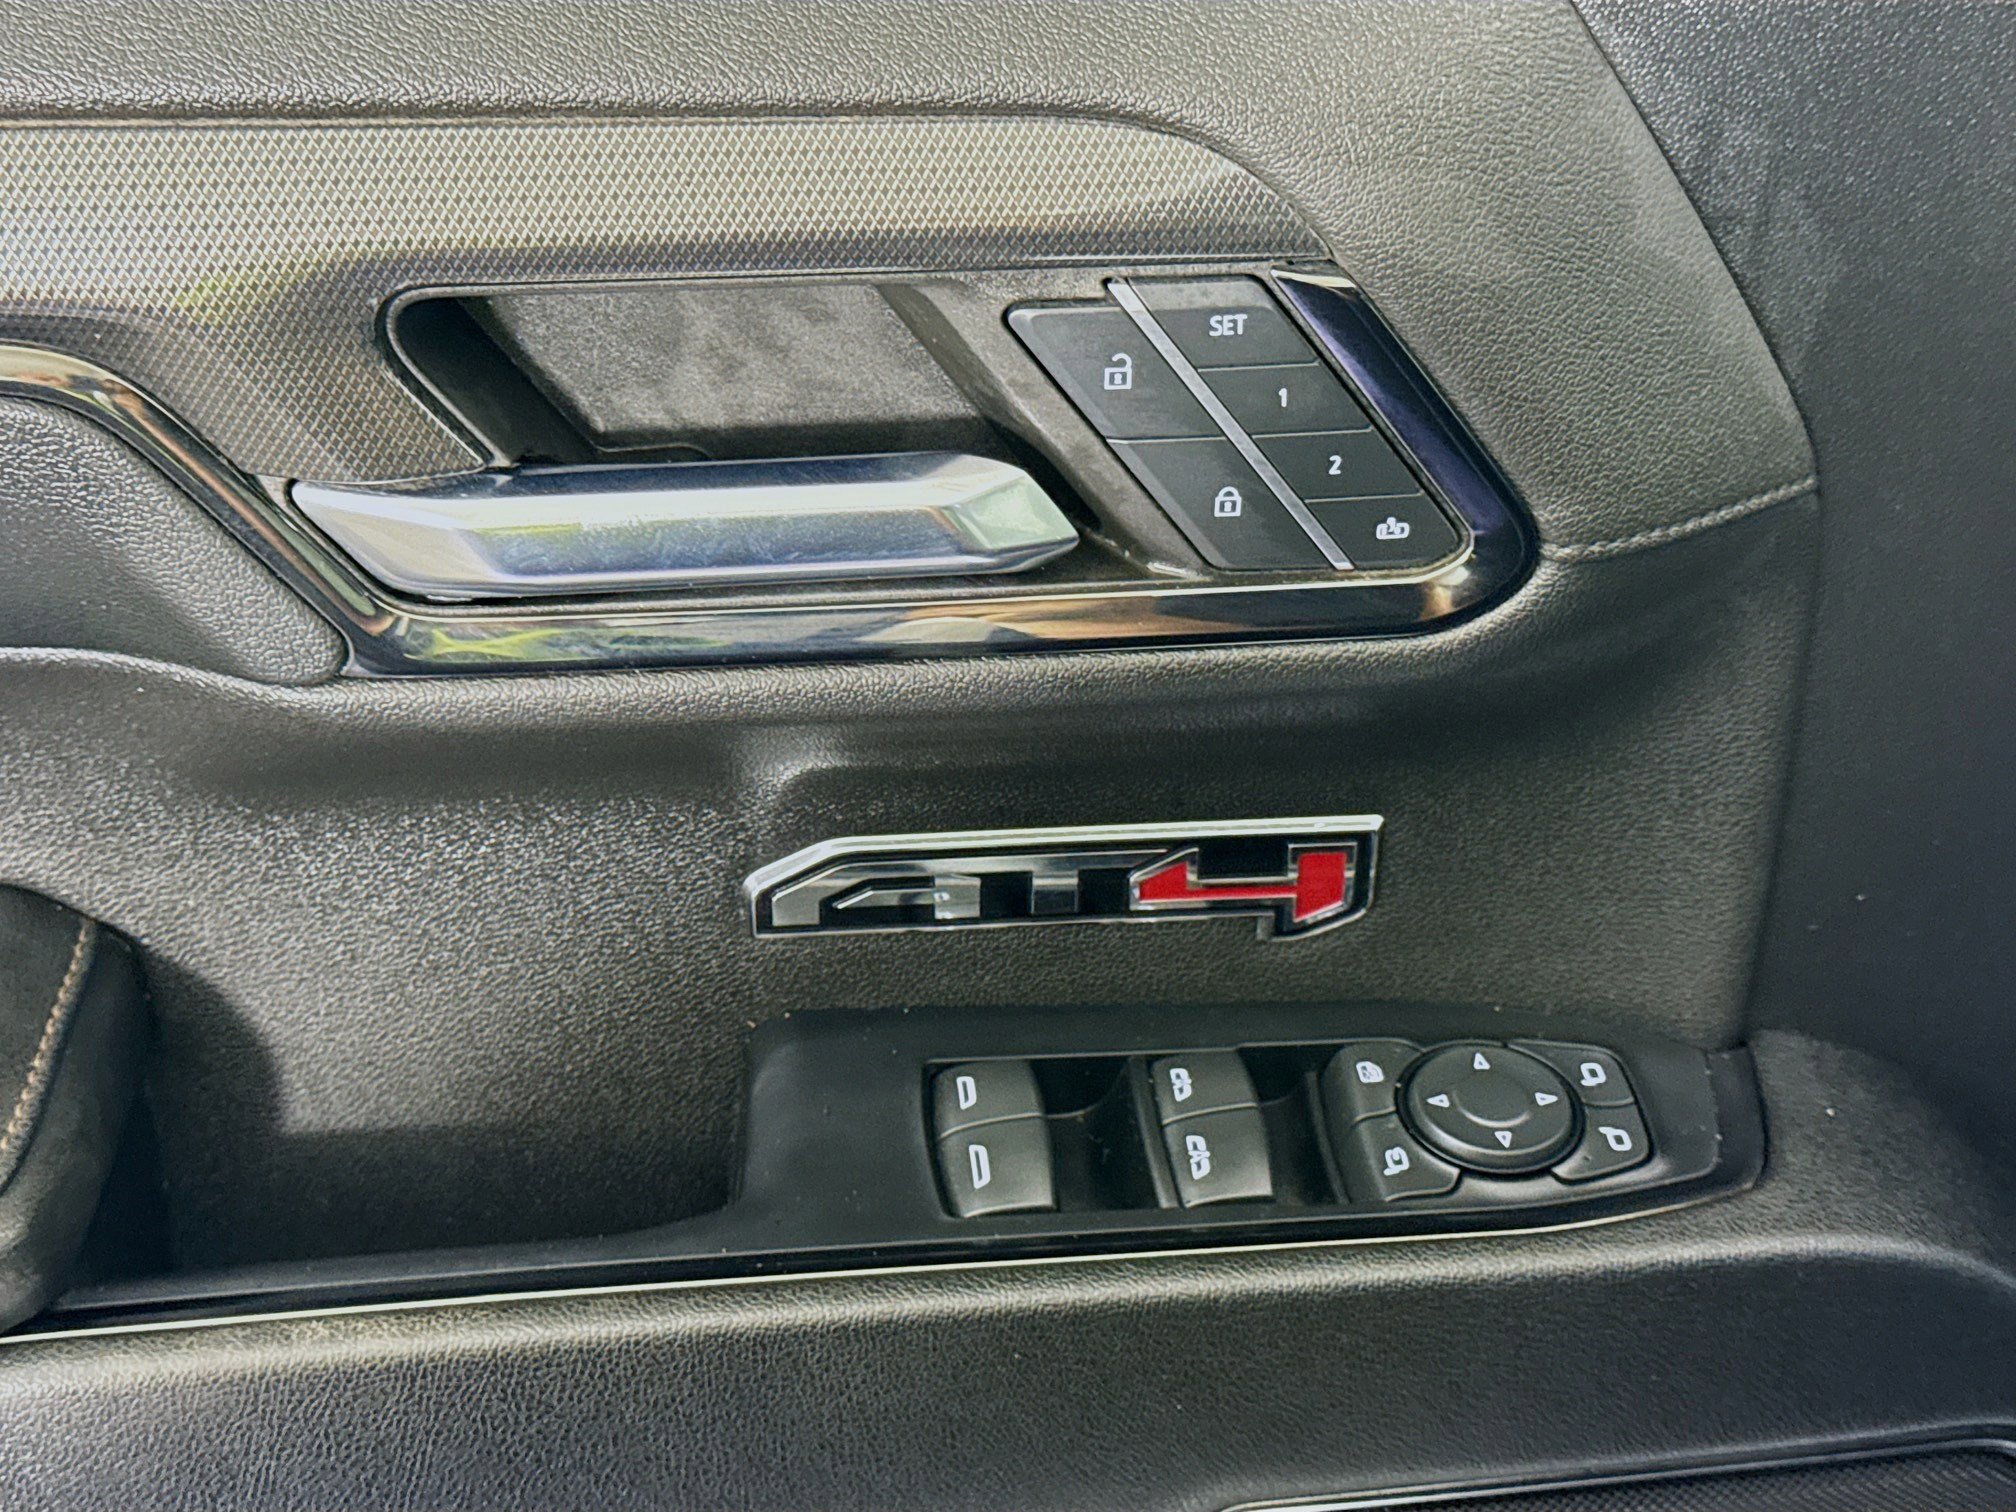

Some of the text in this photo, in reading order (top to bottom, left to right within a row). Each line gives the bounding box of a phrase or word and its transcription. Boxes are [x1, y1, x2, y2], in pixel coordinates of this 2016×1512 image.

[1208, 313, 1248, 337] SET
[1278, 387, 1288, 408] 1
[1328, 454, 1343, 476] 2
